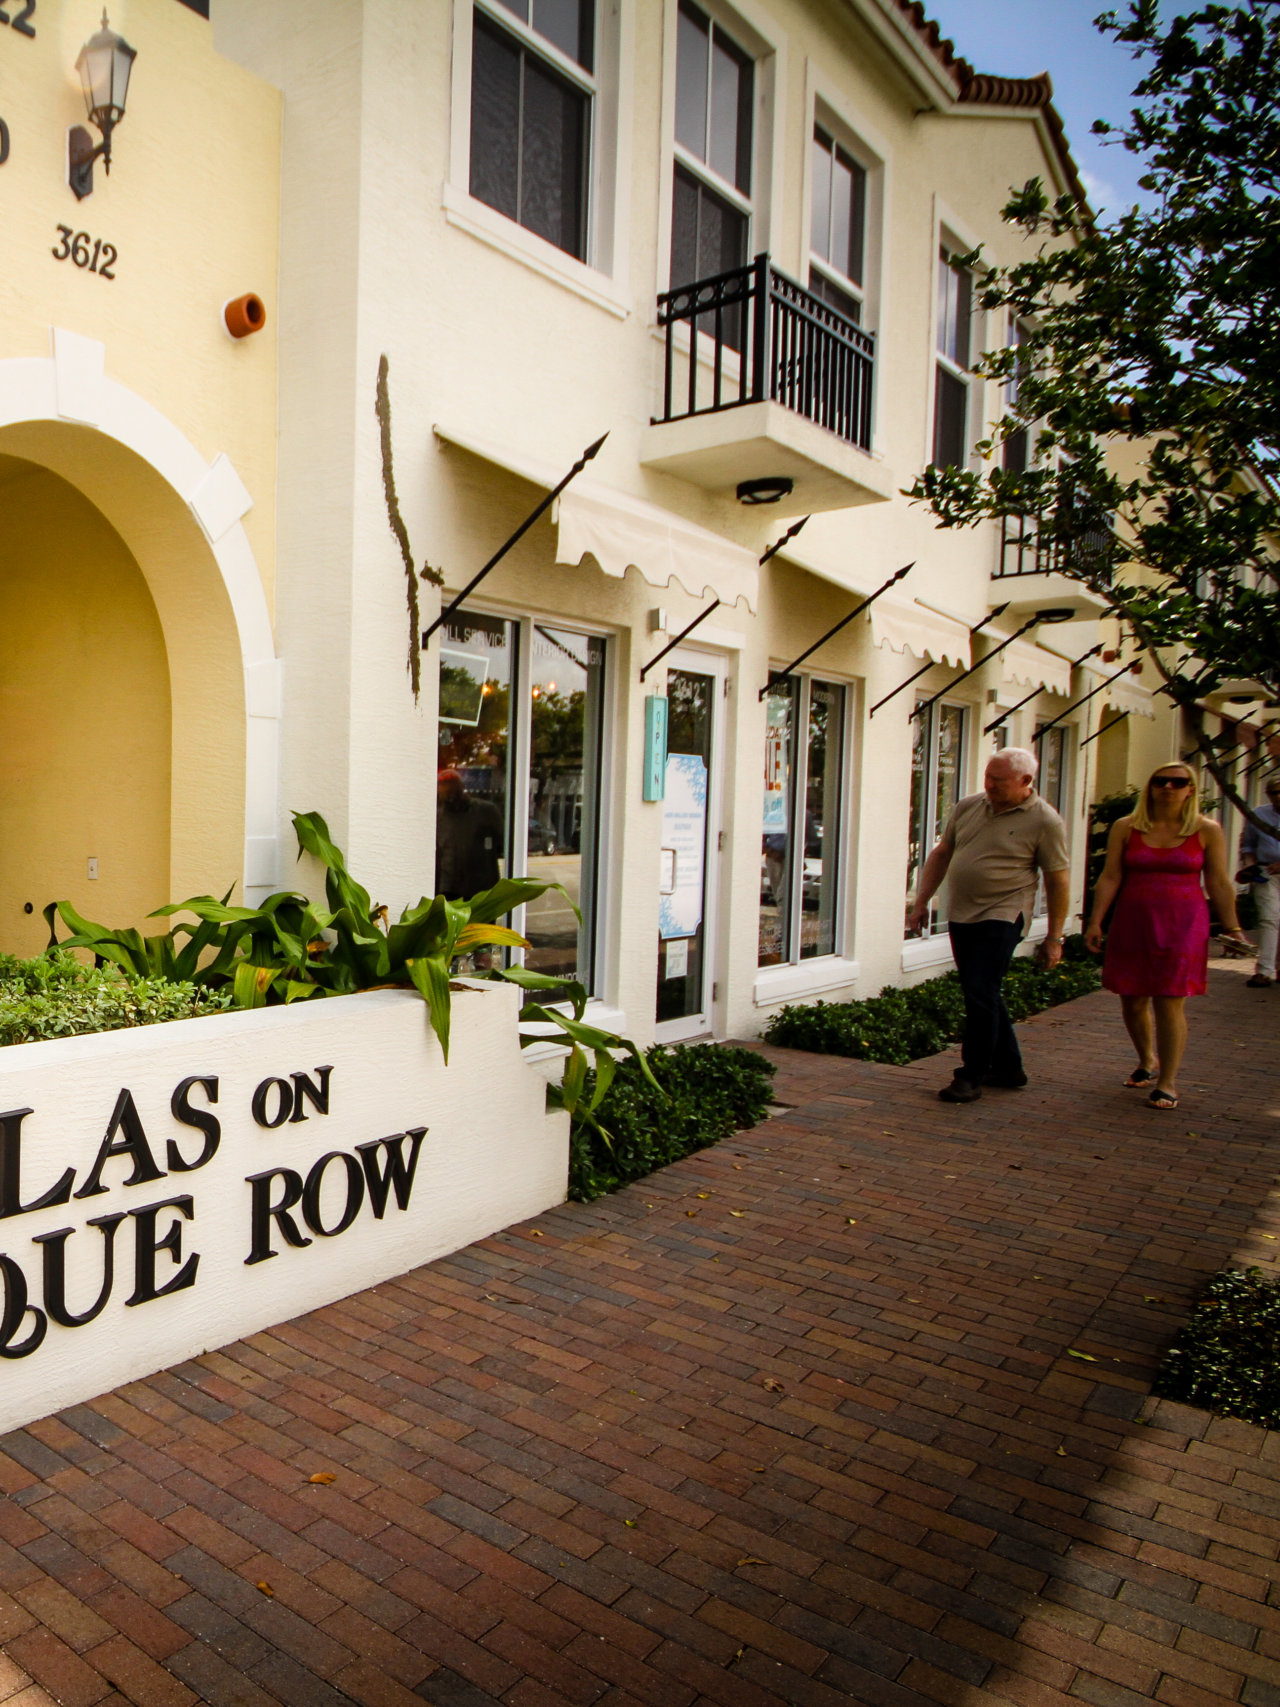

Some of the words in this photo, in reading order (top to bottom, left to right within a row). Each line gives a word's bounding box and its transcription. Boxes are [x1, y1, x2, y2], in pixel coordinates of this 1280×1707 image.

[53, 224, 118, 280] 3612
[252, 1065, 334, 1129] ON
[244, 1126, 429, 1266] ROW
